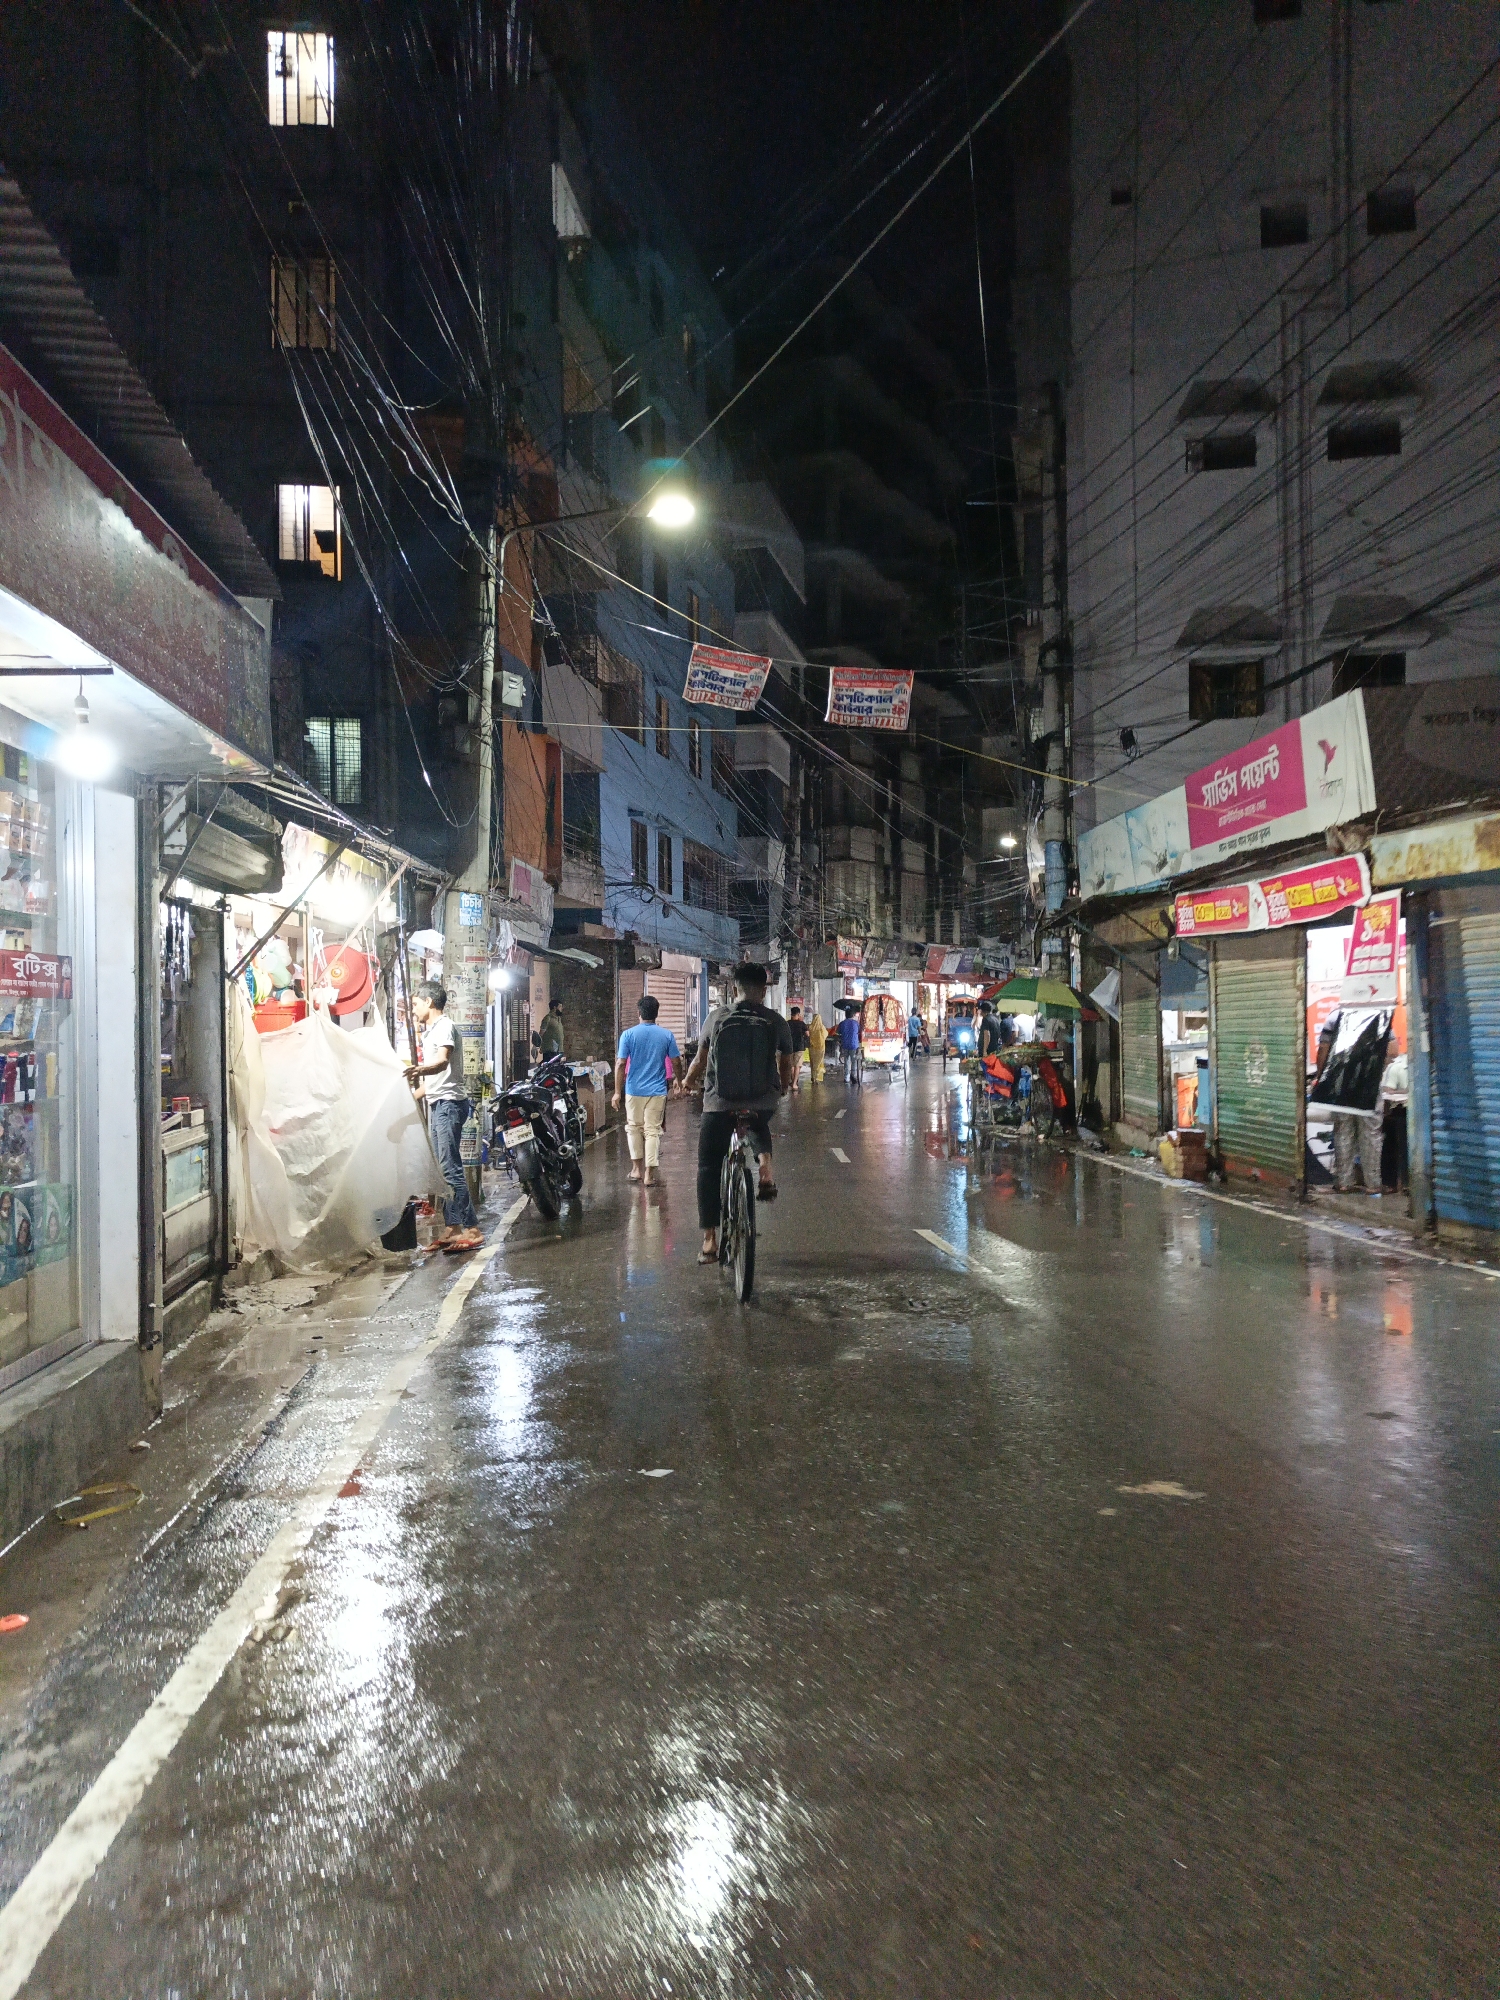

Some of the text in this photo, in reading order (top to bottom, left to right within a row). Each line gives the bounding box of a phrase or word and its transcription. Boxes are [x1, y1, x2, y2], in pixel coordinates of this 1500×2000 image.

[1201, 744, 1280, 808] সার্ভিস পয়েন্ট
[10, 953, 59, 979] বুটিক্স
